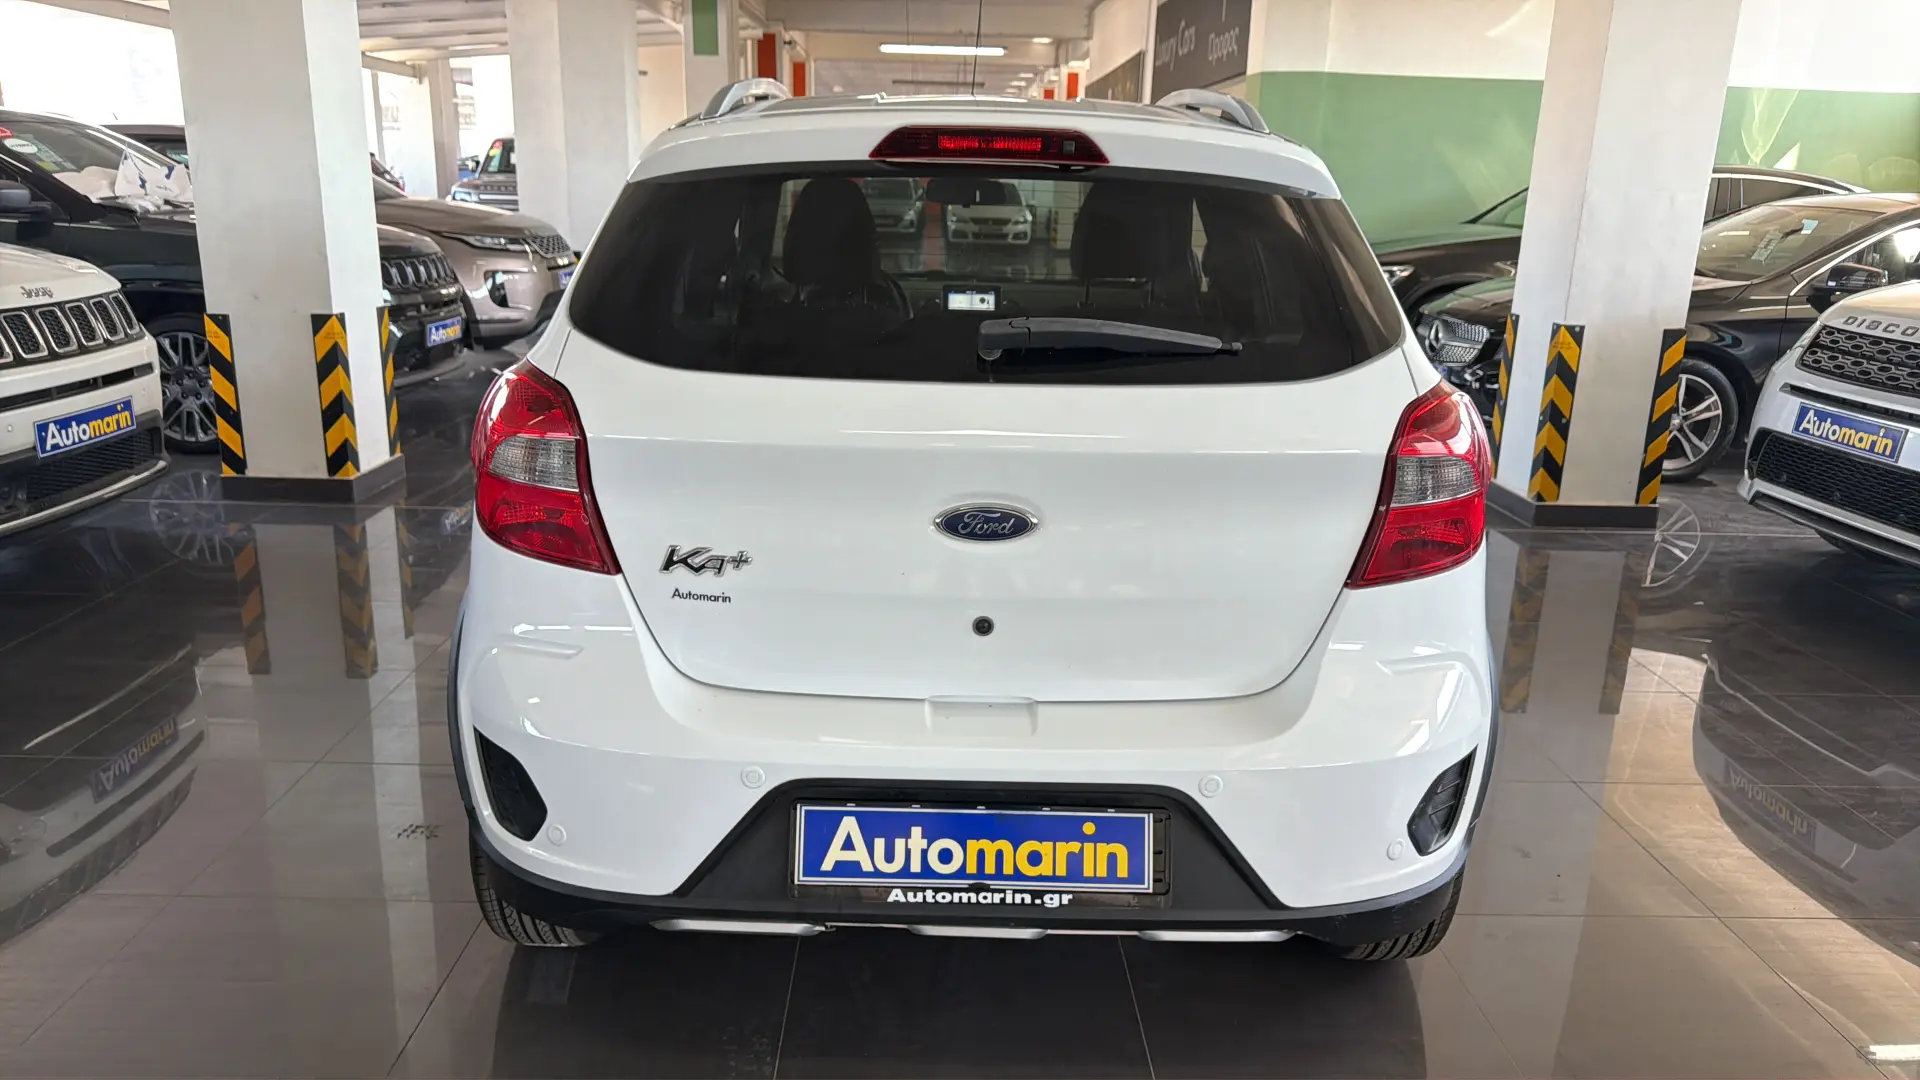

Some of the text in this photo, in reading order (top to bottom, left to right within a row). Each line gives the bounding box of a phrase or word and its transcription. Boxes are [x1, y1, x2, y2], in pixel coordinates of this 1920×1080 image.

[45, 404, 132, 451] Automarin
[1799, 409, 1893, 457] Automarin
[958, 511, 1014, 535] Ford
[671, 588, 732, 604] Automarin
[820, 815, 1129, 878] Automarin
[886, 888, 1073, 908] Automarin.gr
